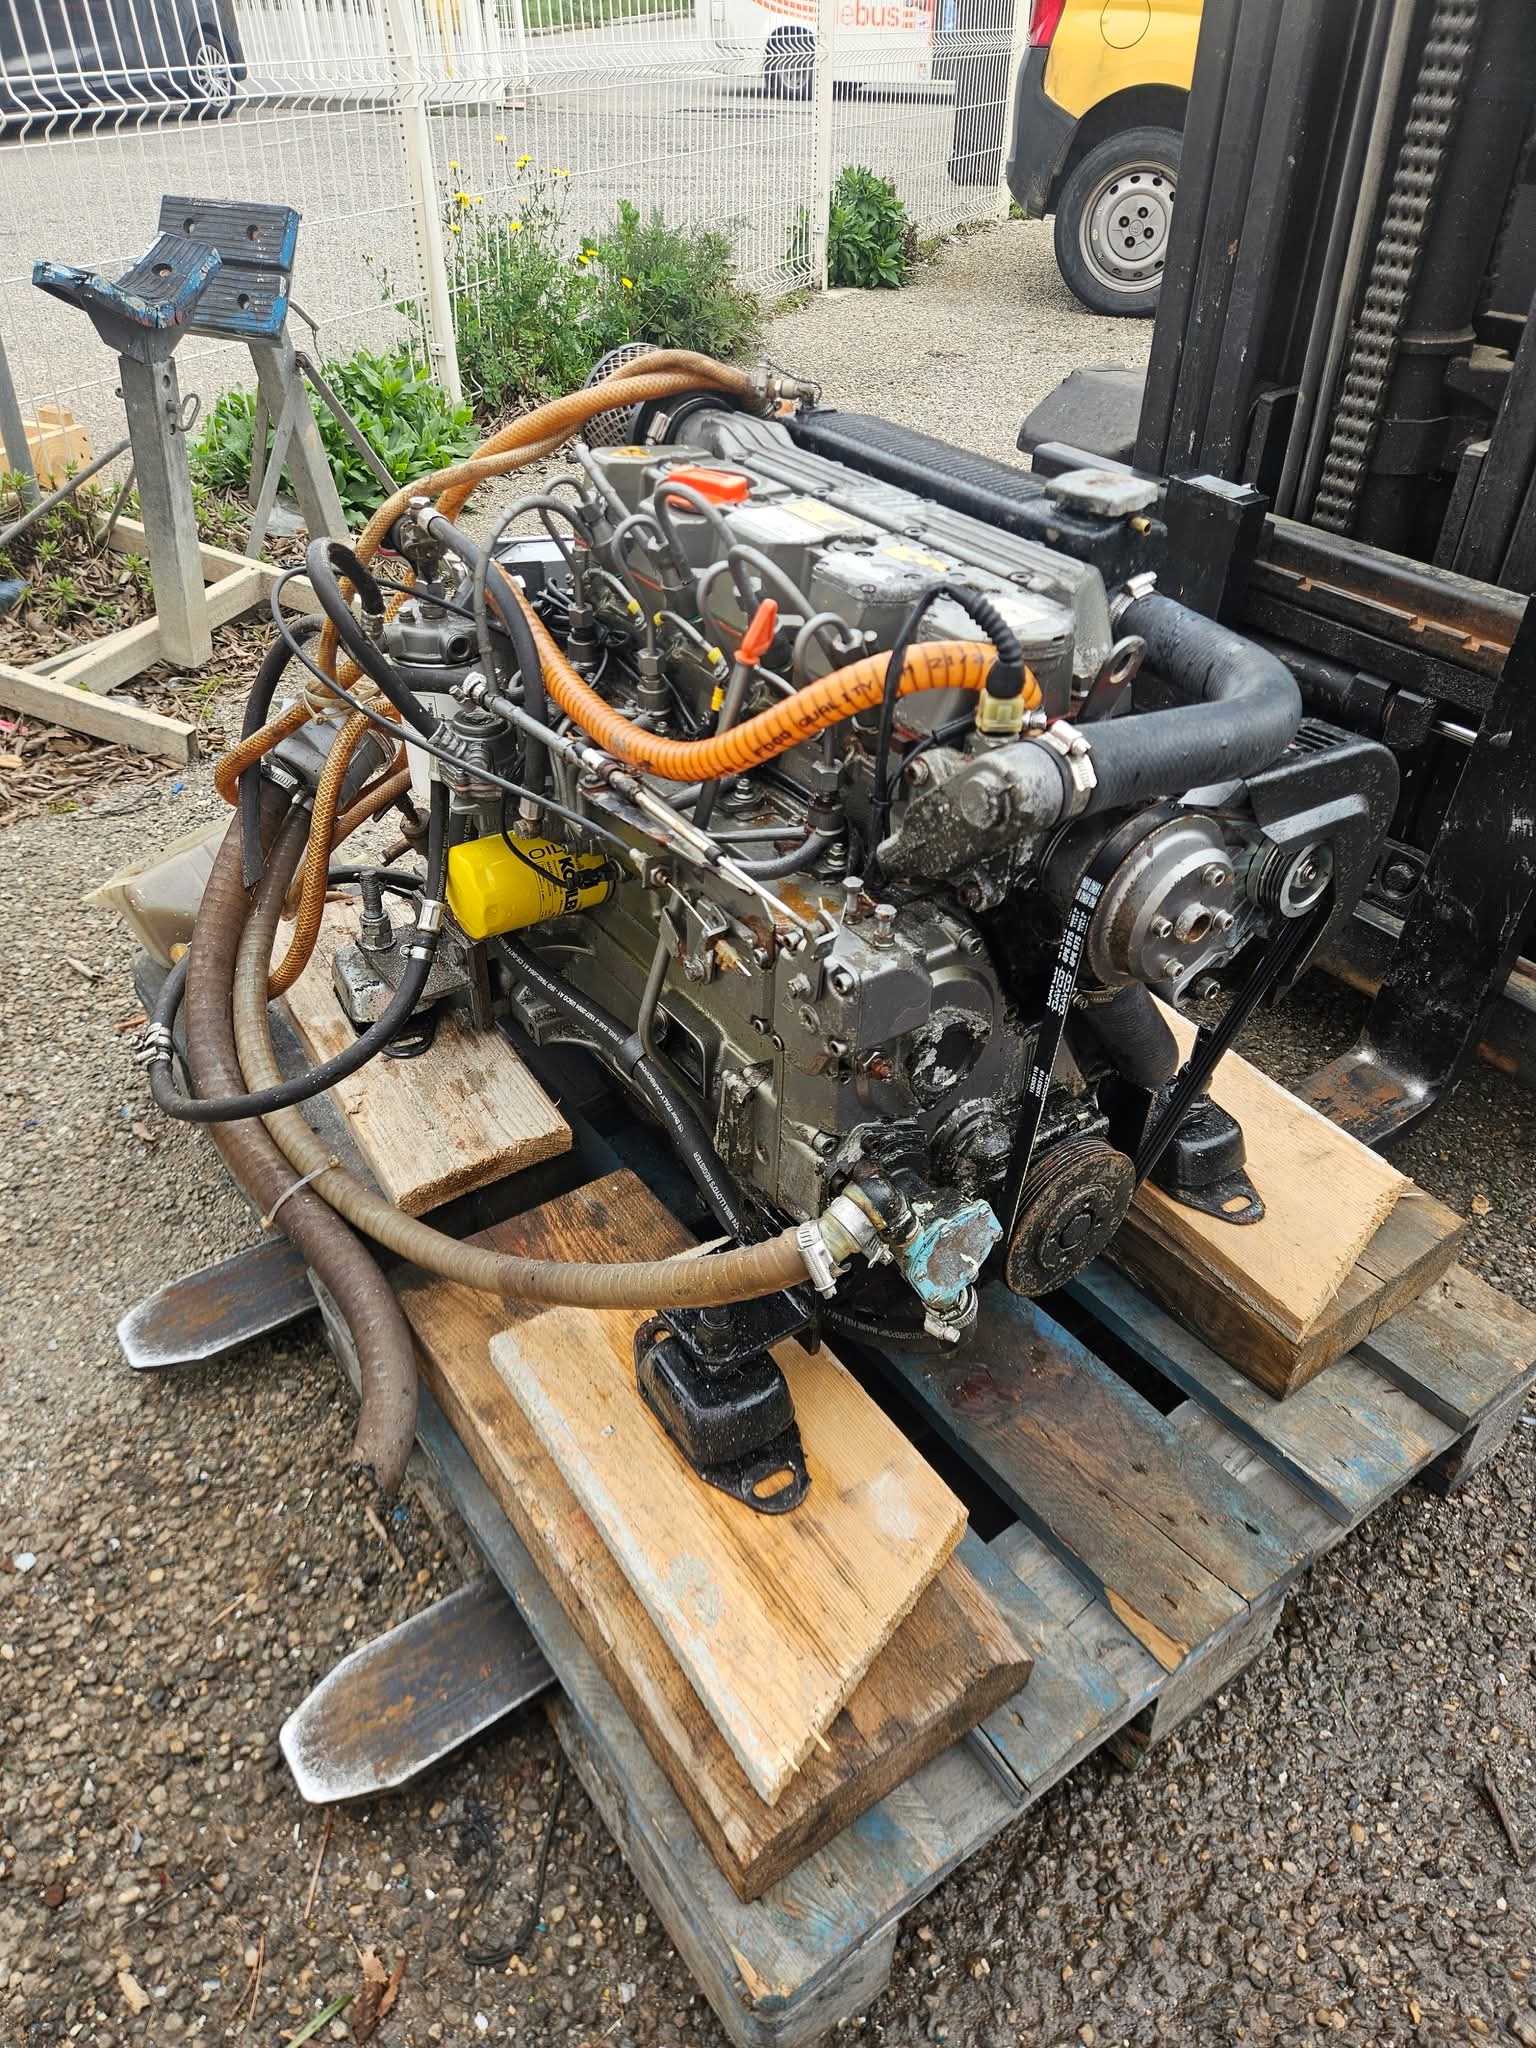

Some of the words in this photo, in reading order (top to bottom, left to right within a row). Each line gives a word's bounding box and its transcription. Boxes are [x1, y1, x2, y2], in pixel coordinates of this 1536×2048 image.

[528, 844, 565, 860] OIL
[1065, 930, 1076, 947] 975
[1072, 935, 1082, 952] 975
[1061, 946, 1071, 964] 4PK
[1068, 951, 1078, 968] 4PK
[1058, 970, 1073, 1017] DAYCO
[599, 1021, 609, 1032] SAE
[608, 1028, 620, 1042] FUEL
[660, 1095, 674, 1112] ITALY
[693, 1151, 713, 1183] REGISTER
